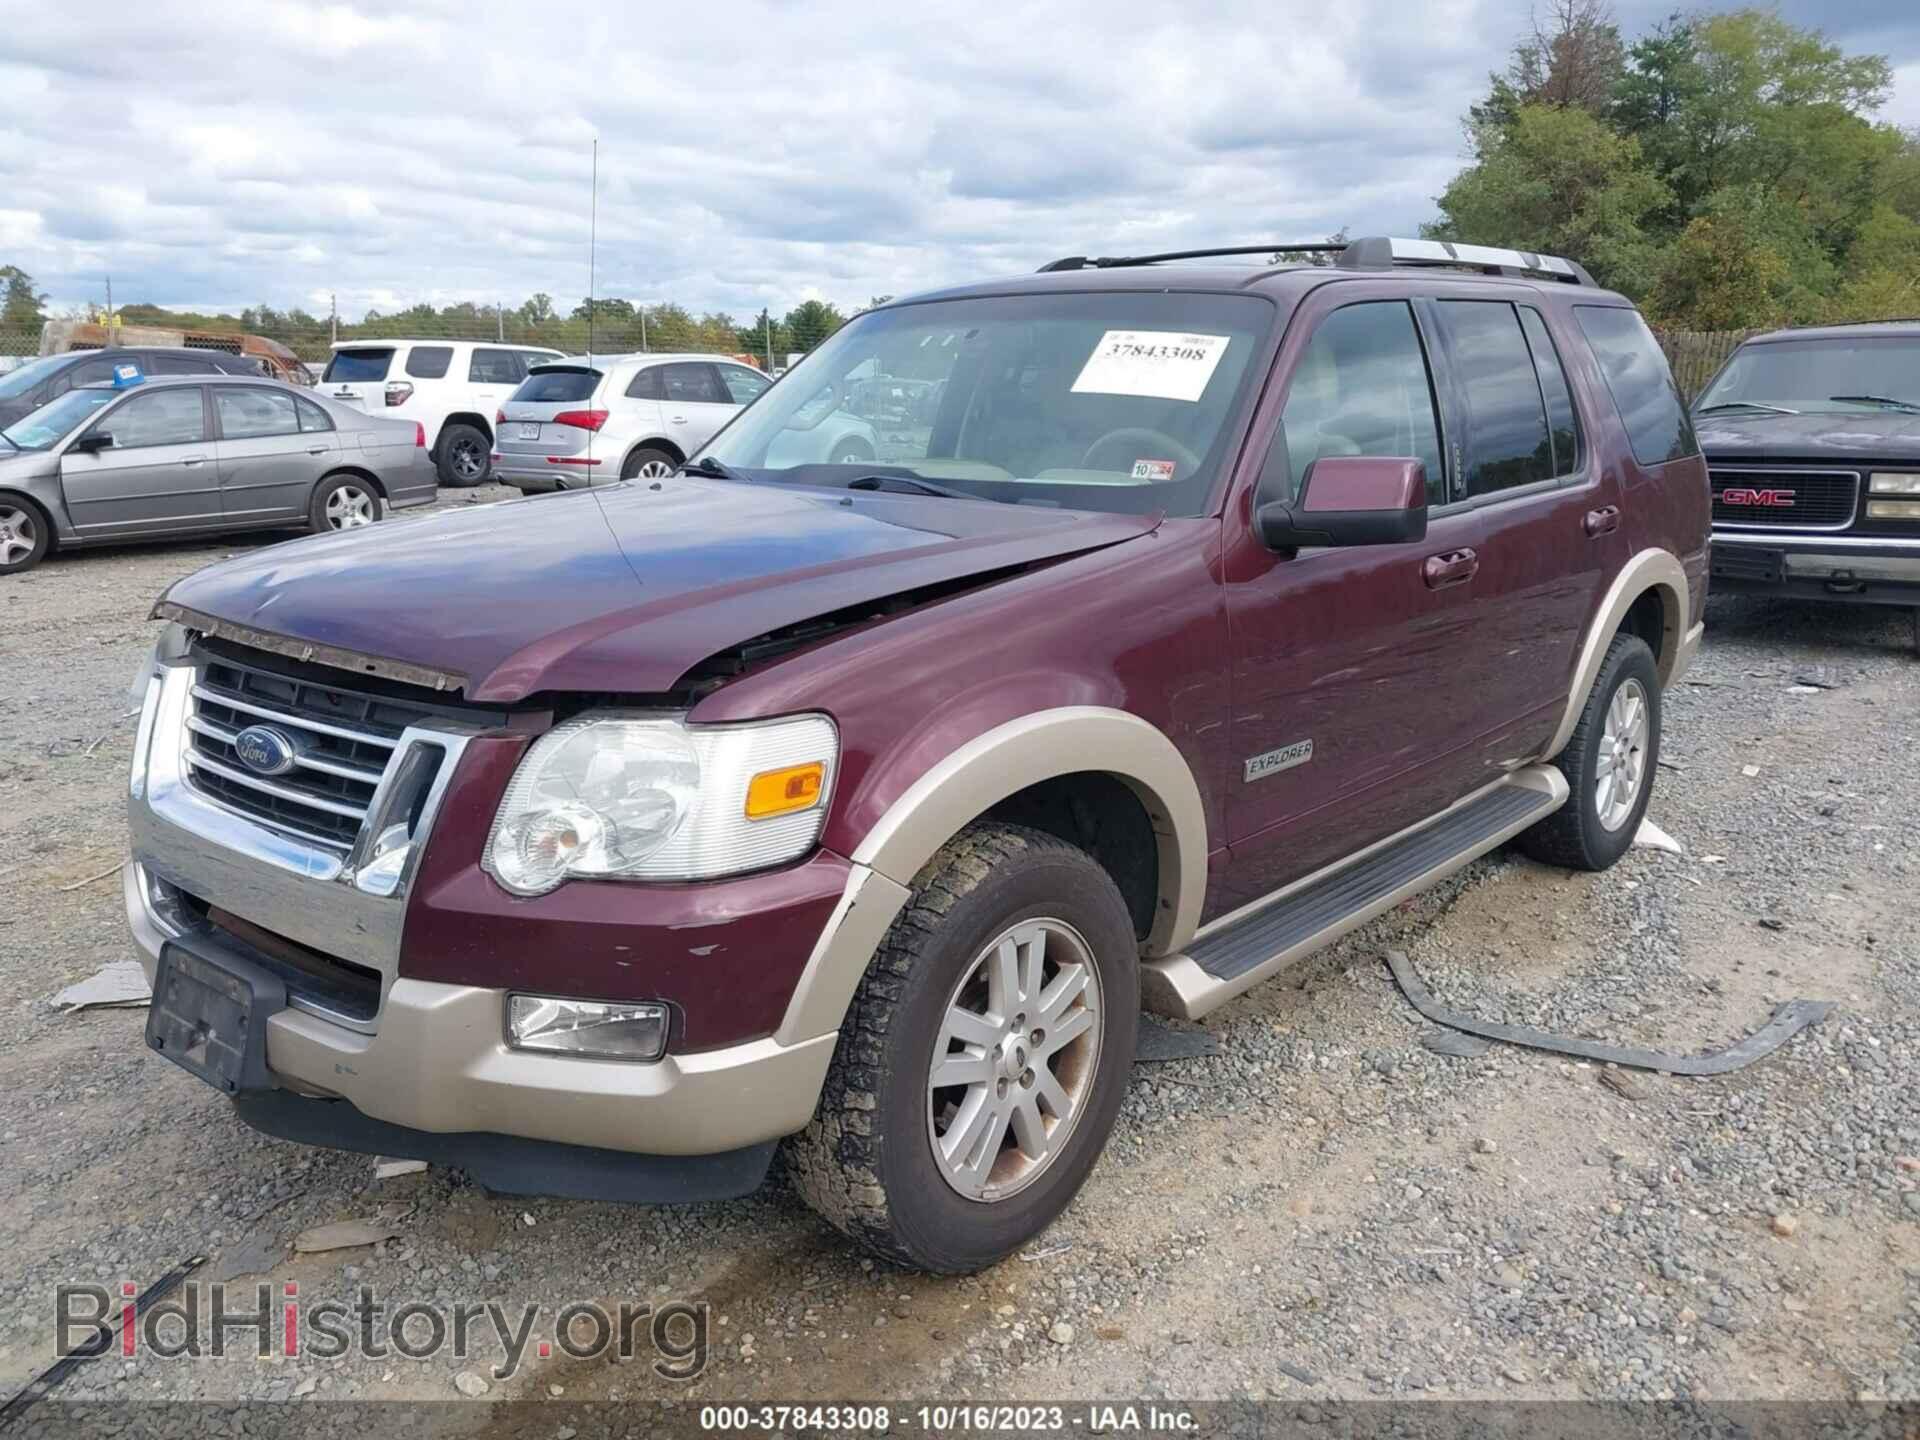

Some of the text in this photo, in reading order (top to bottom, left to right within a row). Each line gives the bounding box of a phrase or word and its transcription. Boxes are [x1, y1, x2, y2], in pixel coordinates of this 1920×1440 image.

[1106, 343, 1206, 361] 37843308
[1135, 465, 1148, 476] 10
[1723, 488, 1796, 506] GMC
[240, 734, 273, 764] Ford
[1249, 743, 1312, 774] EXPLORER
